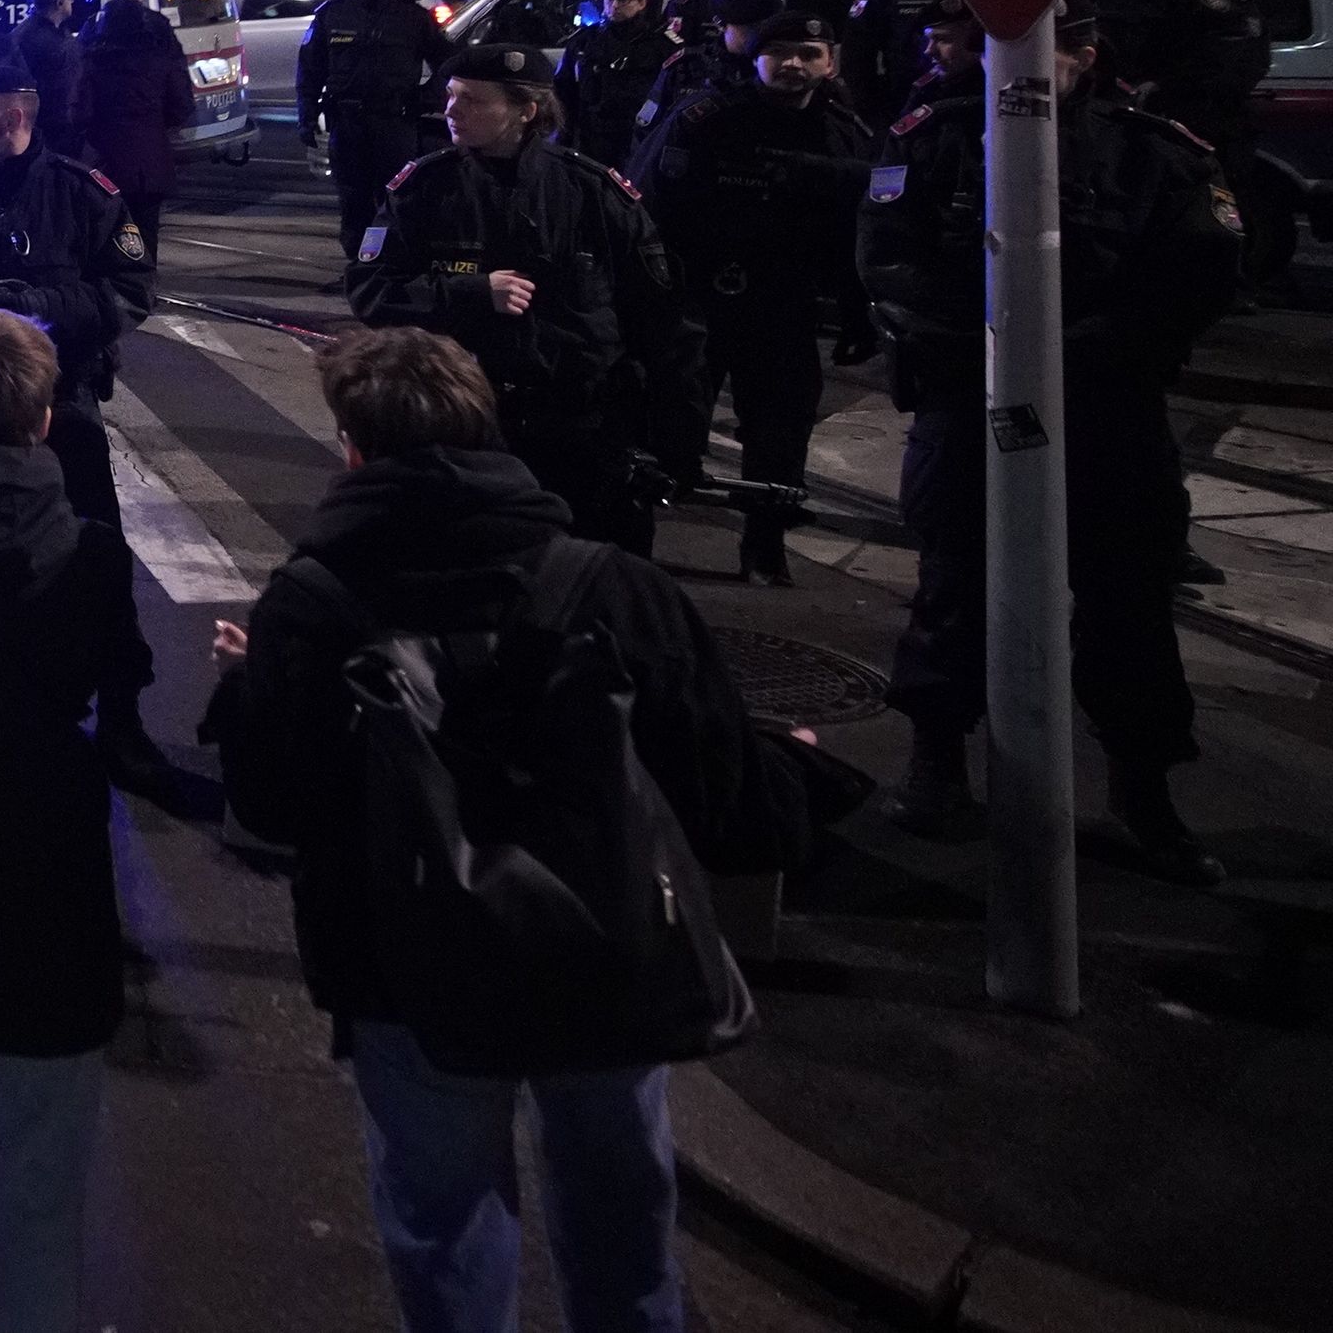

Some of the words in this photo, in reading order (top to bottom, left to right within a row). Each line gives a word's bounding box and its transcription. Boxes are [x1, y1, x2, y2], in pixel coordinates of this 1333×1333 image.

[6, 3, 29, 25] 13
[205, 90, 237, 109] POLIZEI
[431, 259, 478, 275] POLIZEI
